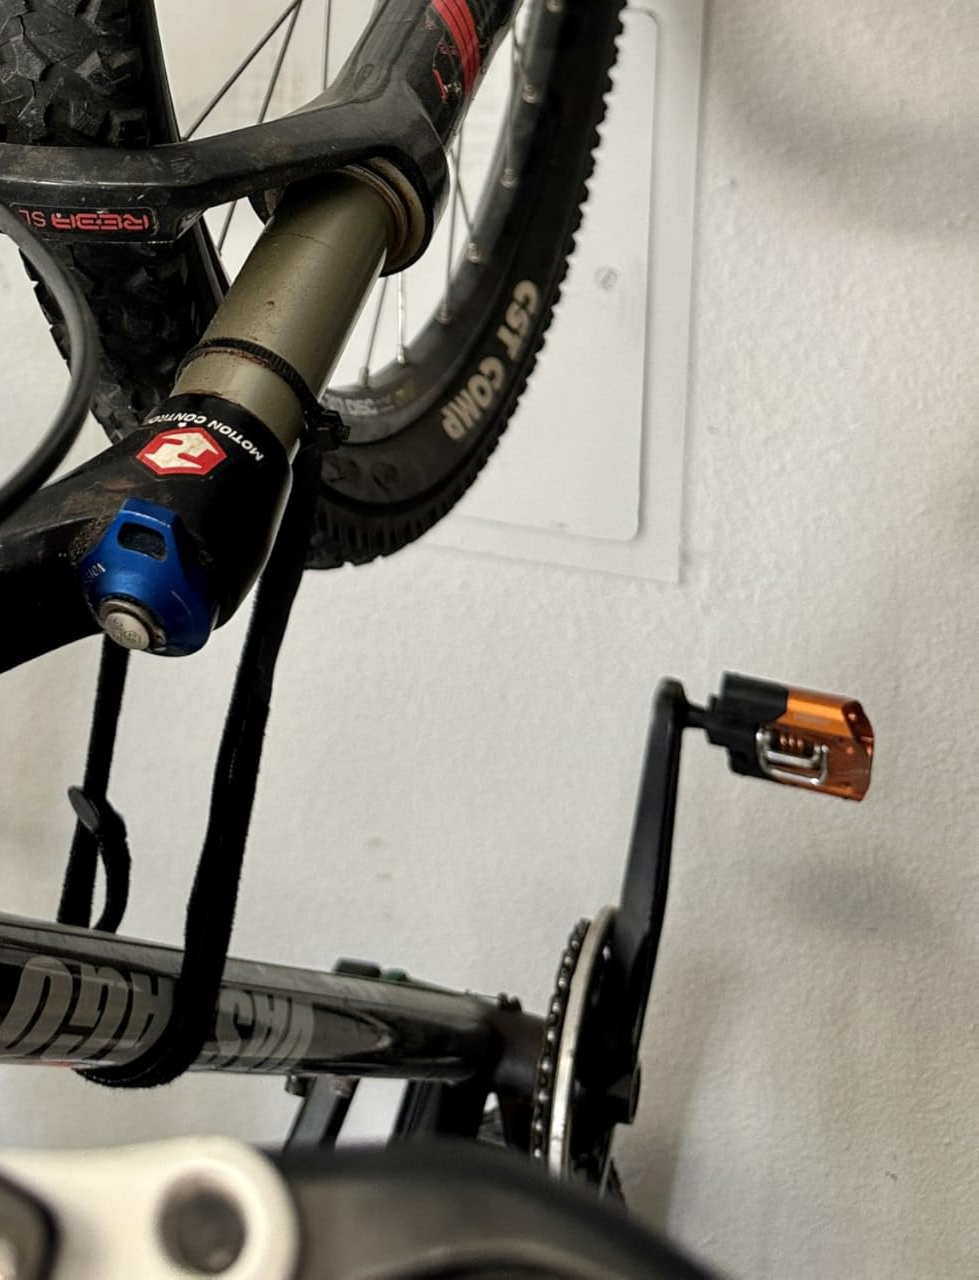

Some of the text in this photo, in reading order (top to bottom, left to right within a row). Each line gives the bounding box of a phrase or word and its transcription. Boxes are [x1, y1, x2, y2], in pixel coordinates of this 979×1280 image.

[18, 208, 150, 231] REBA SL
[438, 280, 539, 441] CST COMP
[147, 411, 265, 462] MOTION CONTRO
